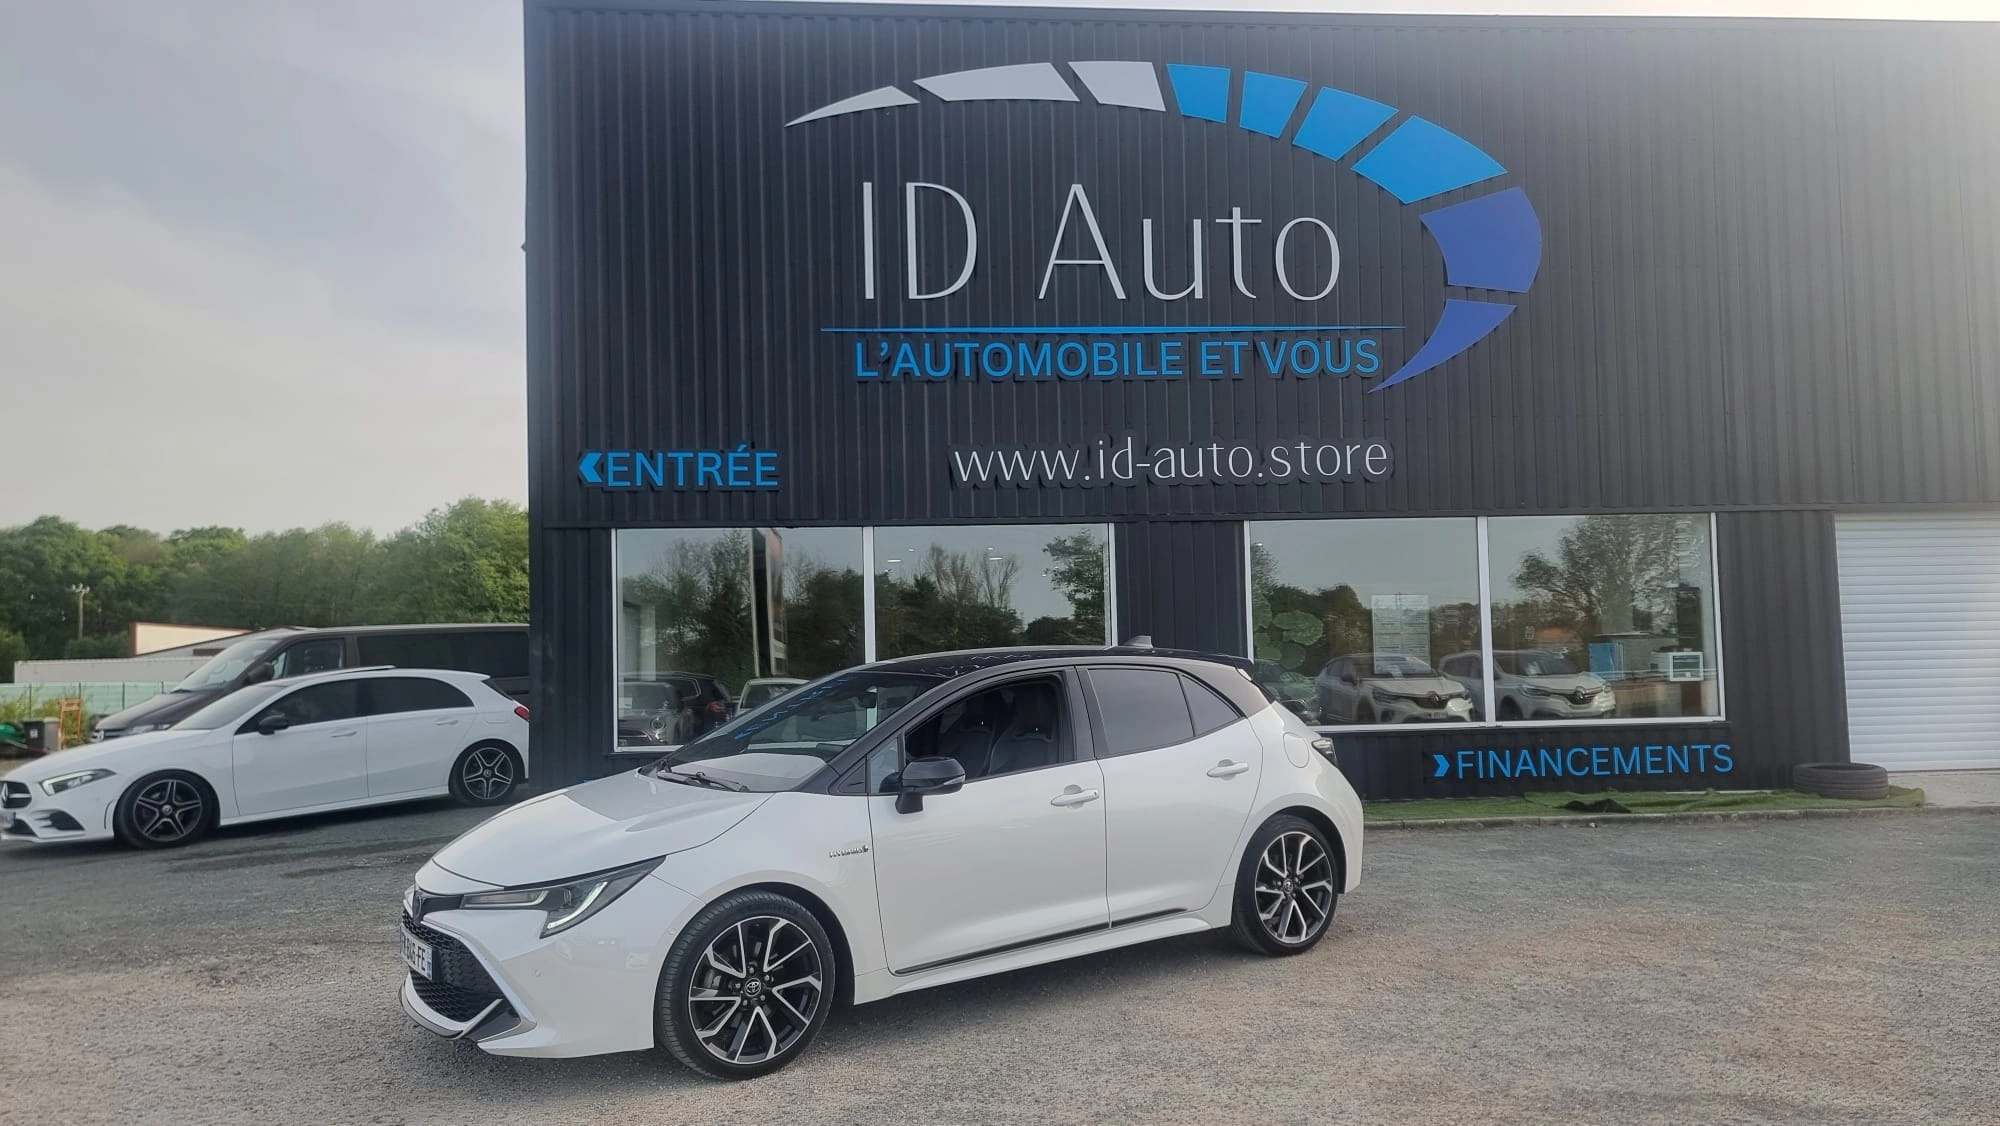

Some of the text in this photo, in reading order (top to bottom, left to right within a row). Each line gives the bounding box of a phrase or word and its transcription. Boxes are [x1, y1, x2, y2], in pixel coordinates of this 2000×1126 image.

[862, 181, 1342, 302] ID Auto
[1200, 341, 1250, 376] ET
[1260, 338, 1381, 375] VOUS
[606, 443, 779, 487] ENTRÉE
[953, 435, 1389, 483] www.id-auto.store
[1456, 743, 1735, 779] FINANCEMENTS
